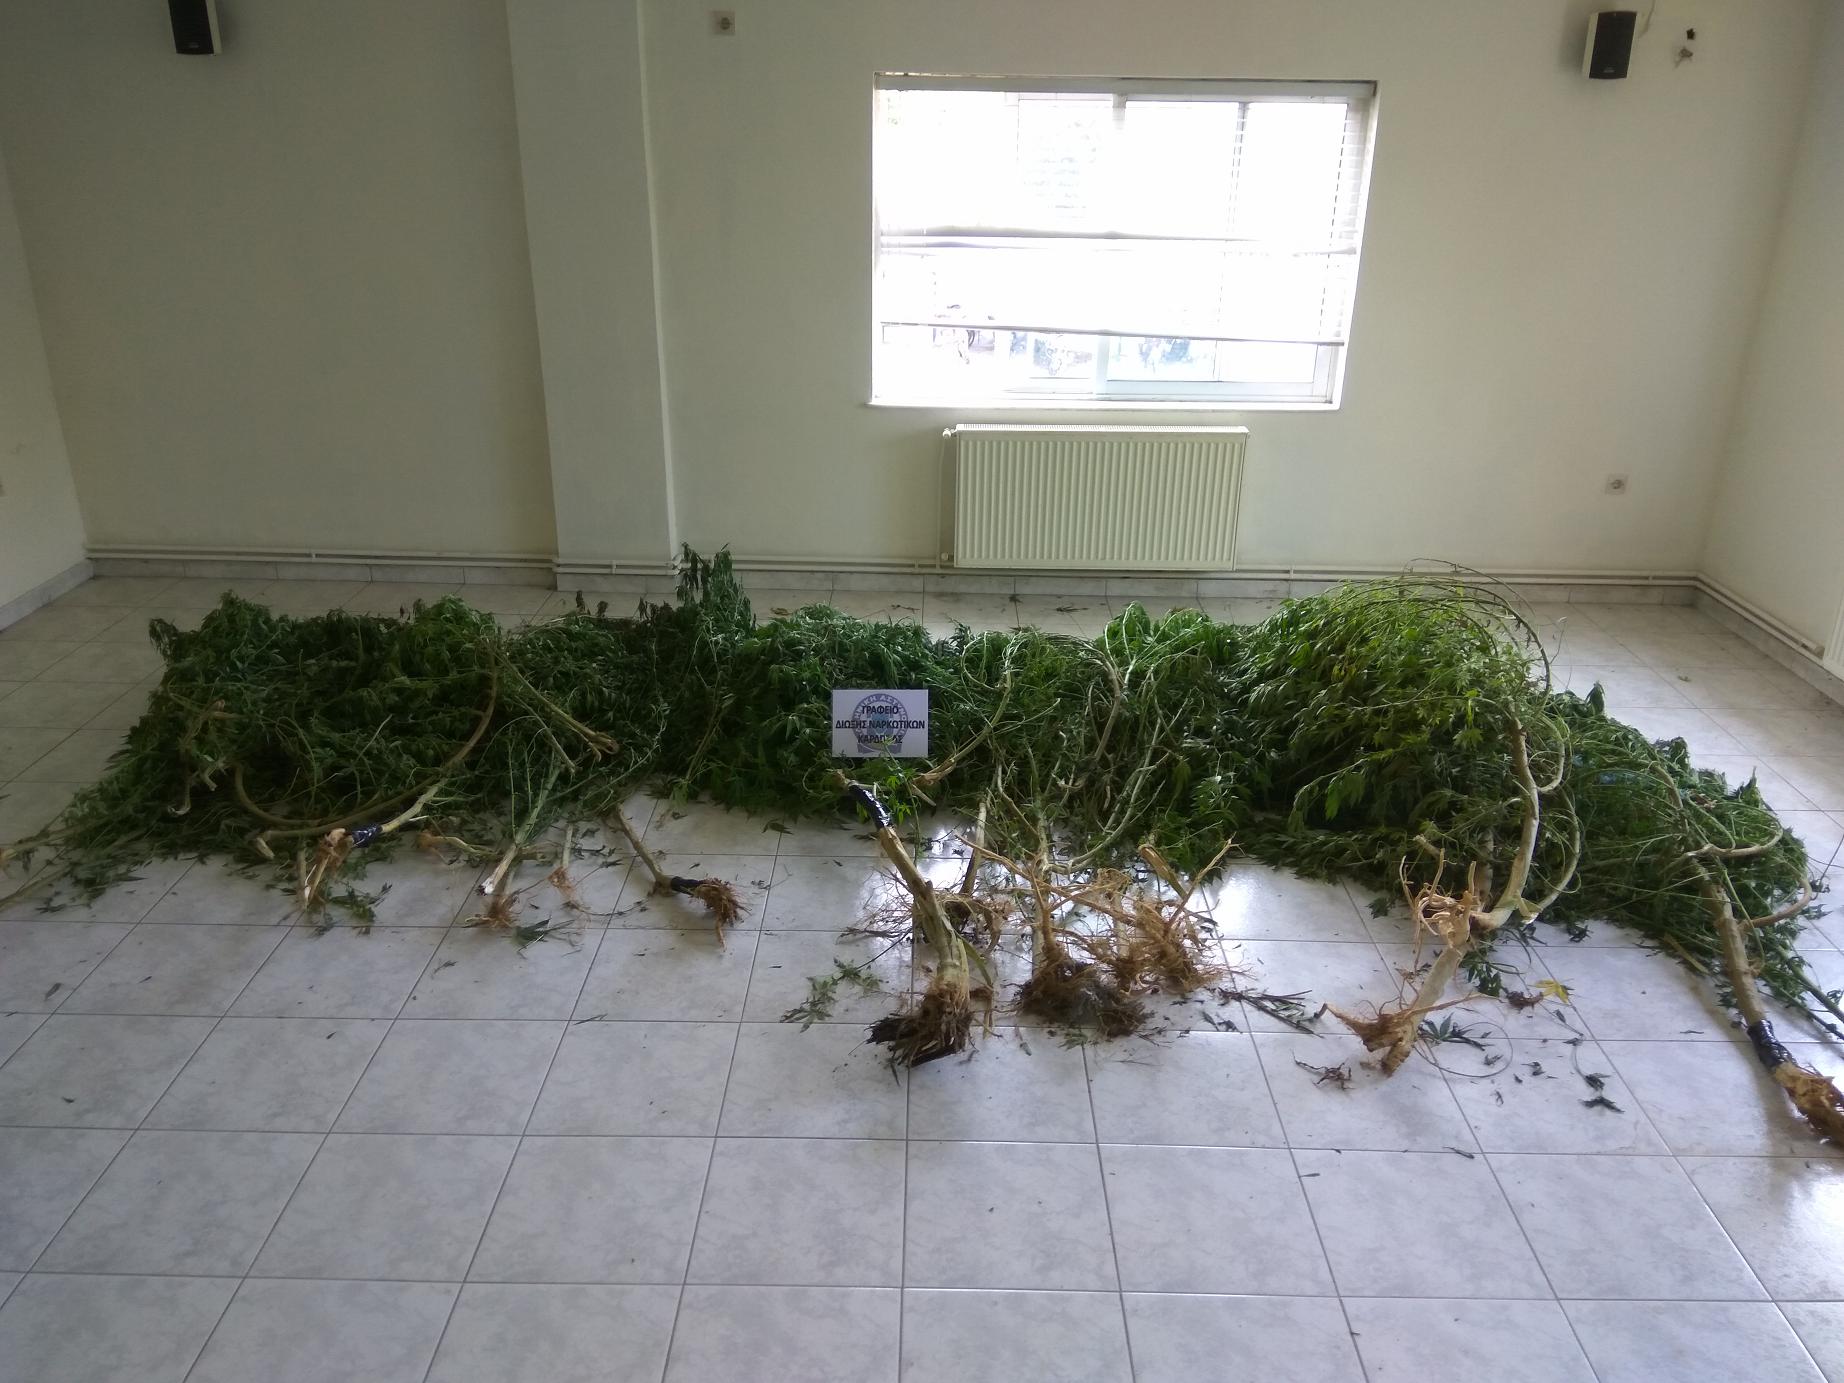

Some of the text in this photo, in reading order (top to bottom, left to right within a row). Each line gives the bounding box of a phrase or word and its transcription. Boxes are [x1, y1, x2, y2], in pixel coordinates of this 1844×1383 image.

[862, 705, 899, 715] ΓΡΑΦΕΙΟ
[835, 720, 925, 729] ΔΙΩΞΗΣ ΝΑΡΚΩΤΙΚΩΝ
[857, 735, 903, 744] ΚΑΡΔΙΤΑΣ
